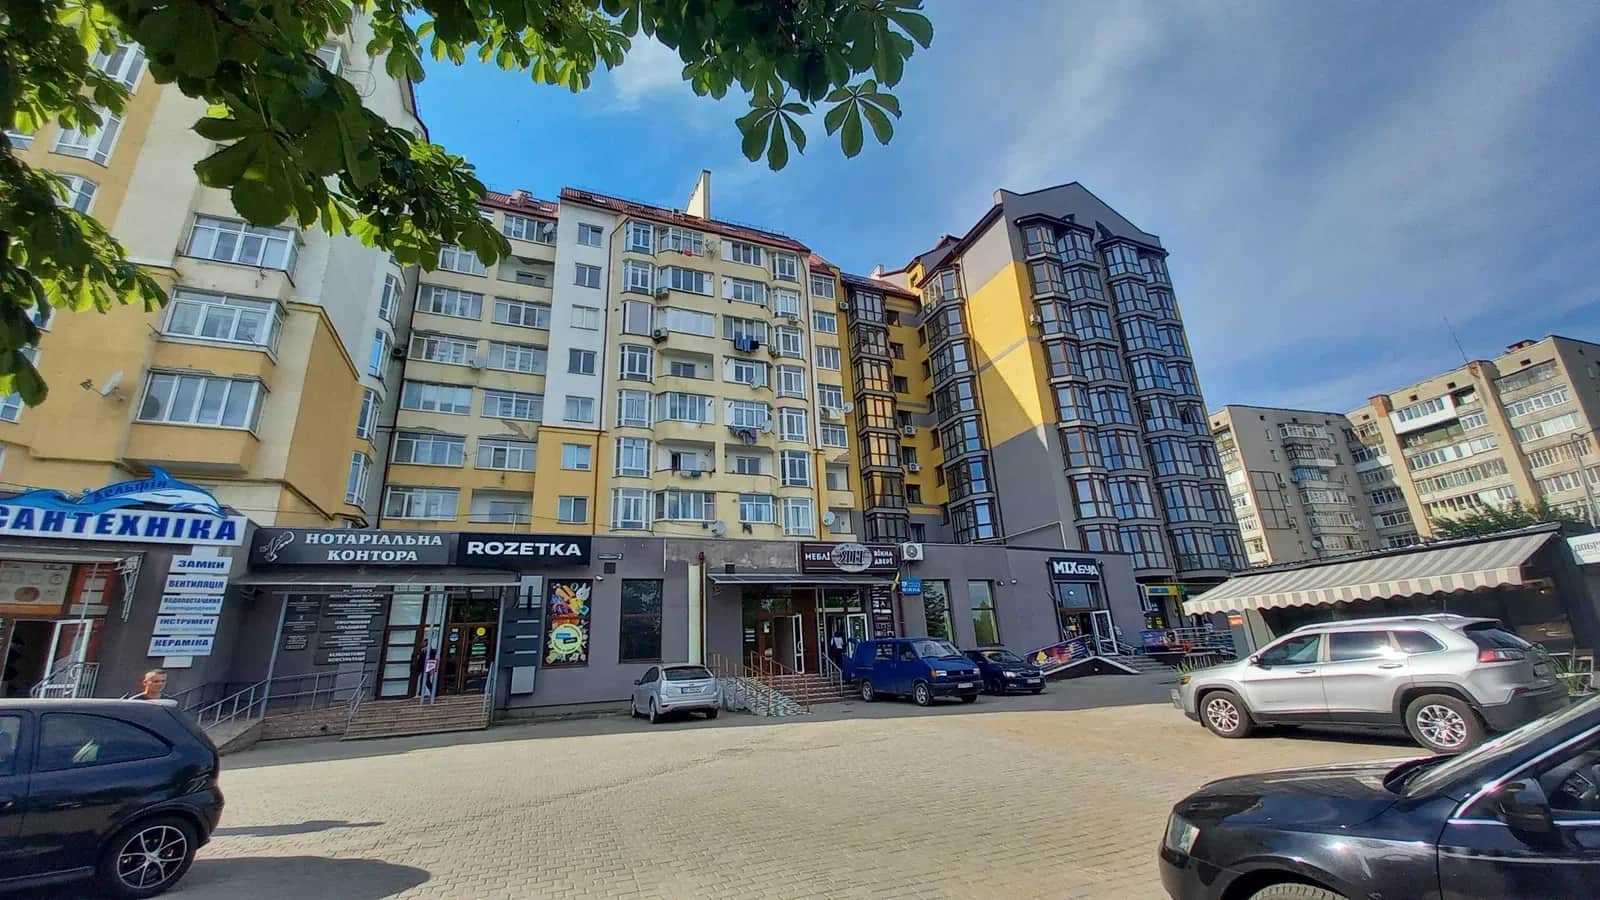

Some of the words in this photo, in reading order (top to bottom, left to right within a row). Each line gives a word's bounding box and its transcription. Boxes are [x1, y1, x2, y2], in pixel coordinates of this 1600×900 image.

[304, 533, 443, 545] НОТАРІАЛЬНА
[466, 541, 582, 556] ROZETKA
[327, 550, 418, 561] КОНТОРА
[805, 551, 831, 561] МЕБЛІ
[177, 560, 225, 569] ЗАМКИ
[154, 639, 209, 647] КЕРАМІКА
